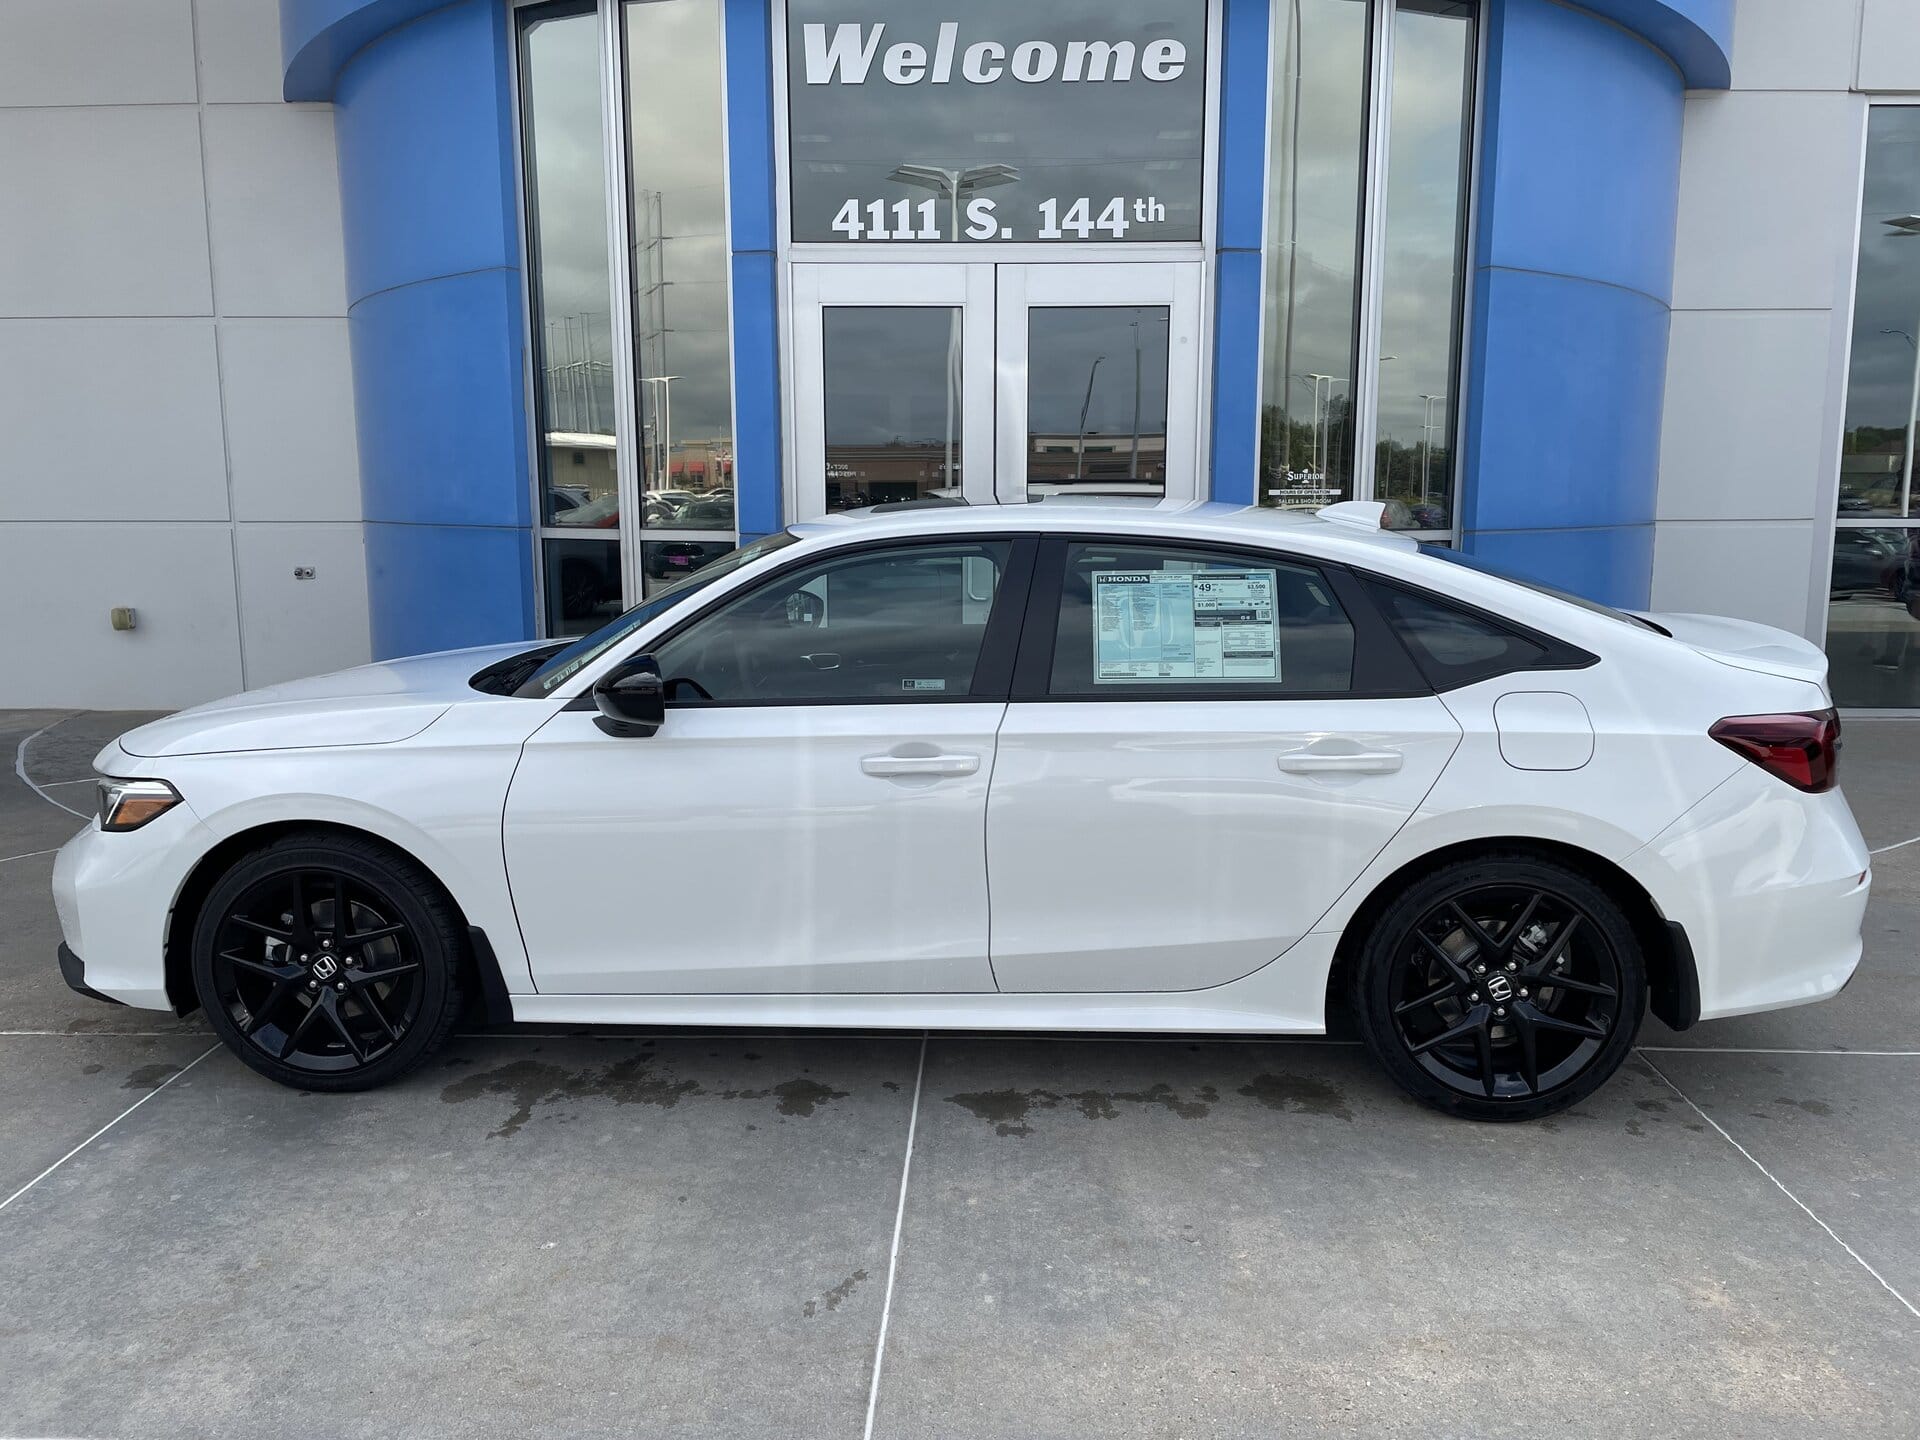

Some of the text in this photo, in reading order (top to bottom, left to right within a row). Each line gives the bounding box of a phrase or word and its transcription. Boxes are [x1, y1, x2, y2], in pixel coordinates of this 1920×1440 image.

[803, 22, 1187, 84] Welcome
[831, 198, 941, 240] 4111
[965, 198, 1013, 240] S.
[1199, 583, 1211, 592] 49
